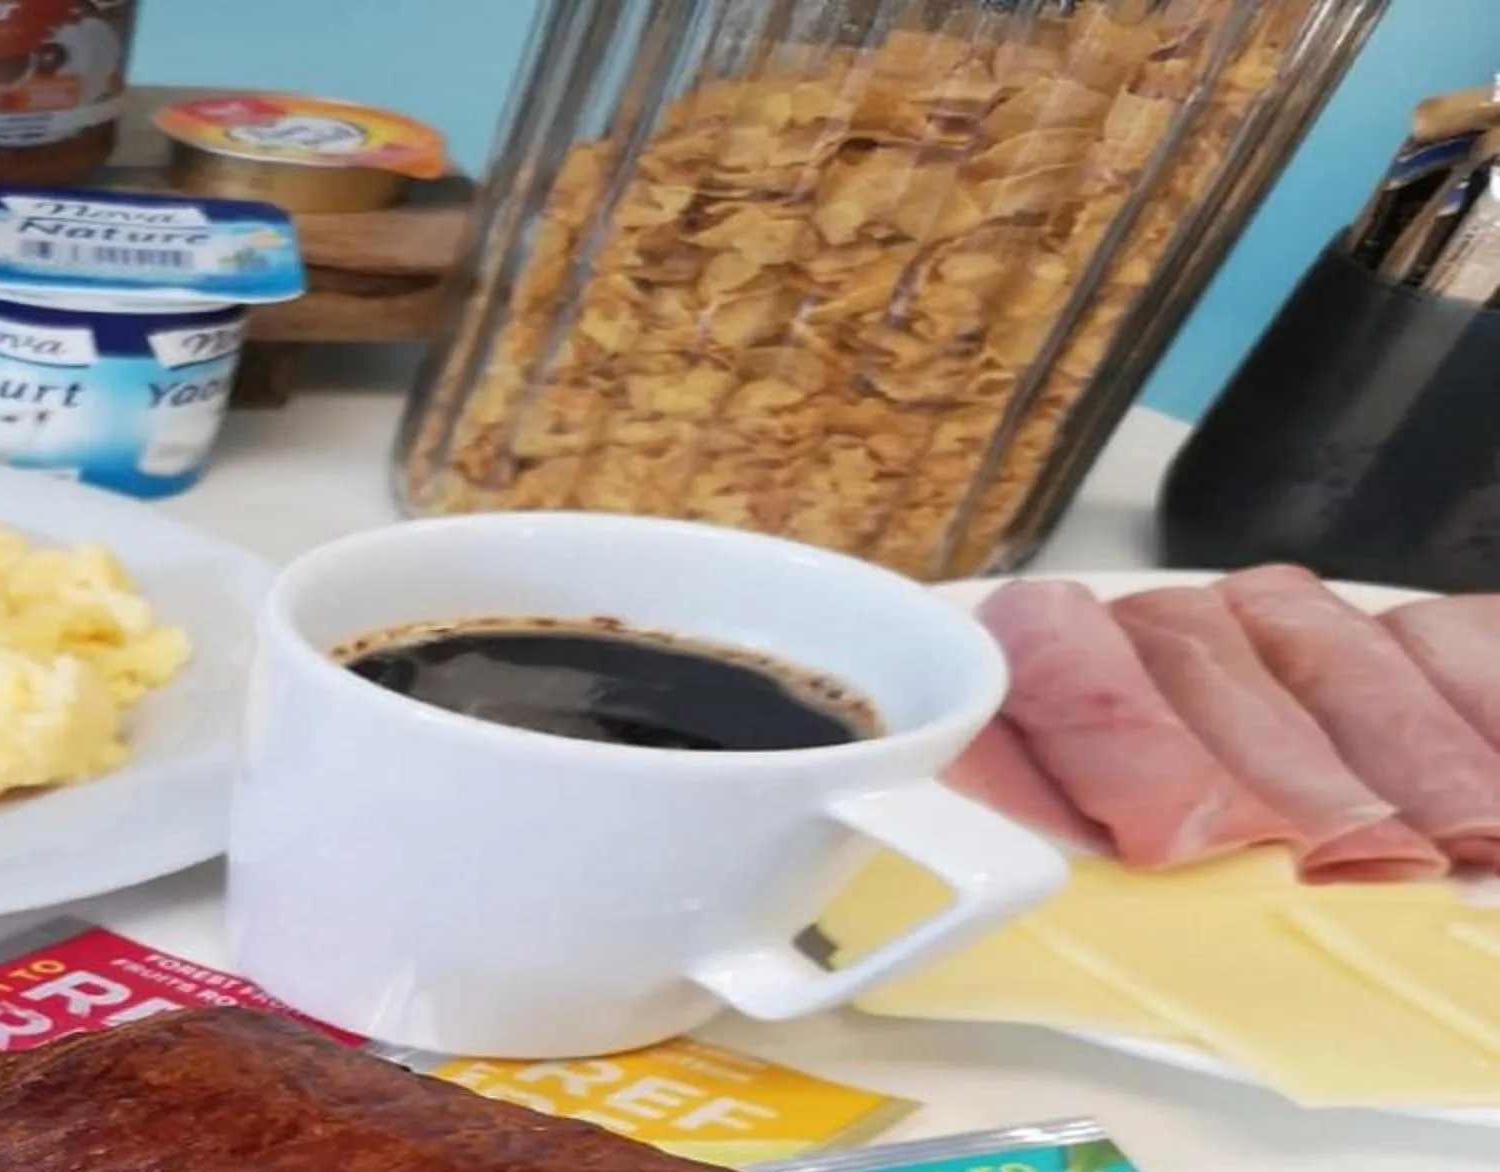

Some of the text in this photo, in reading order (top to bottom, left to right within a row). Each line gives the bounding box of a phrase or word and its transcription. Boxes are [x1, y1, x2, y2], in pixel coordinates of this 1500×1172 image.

[34, 200, 176, 225] Nova
[16, 219, 212, 246] Nature
[8, 958, 67, 983] TO
[144, 953, 243, 989] FOREST
